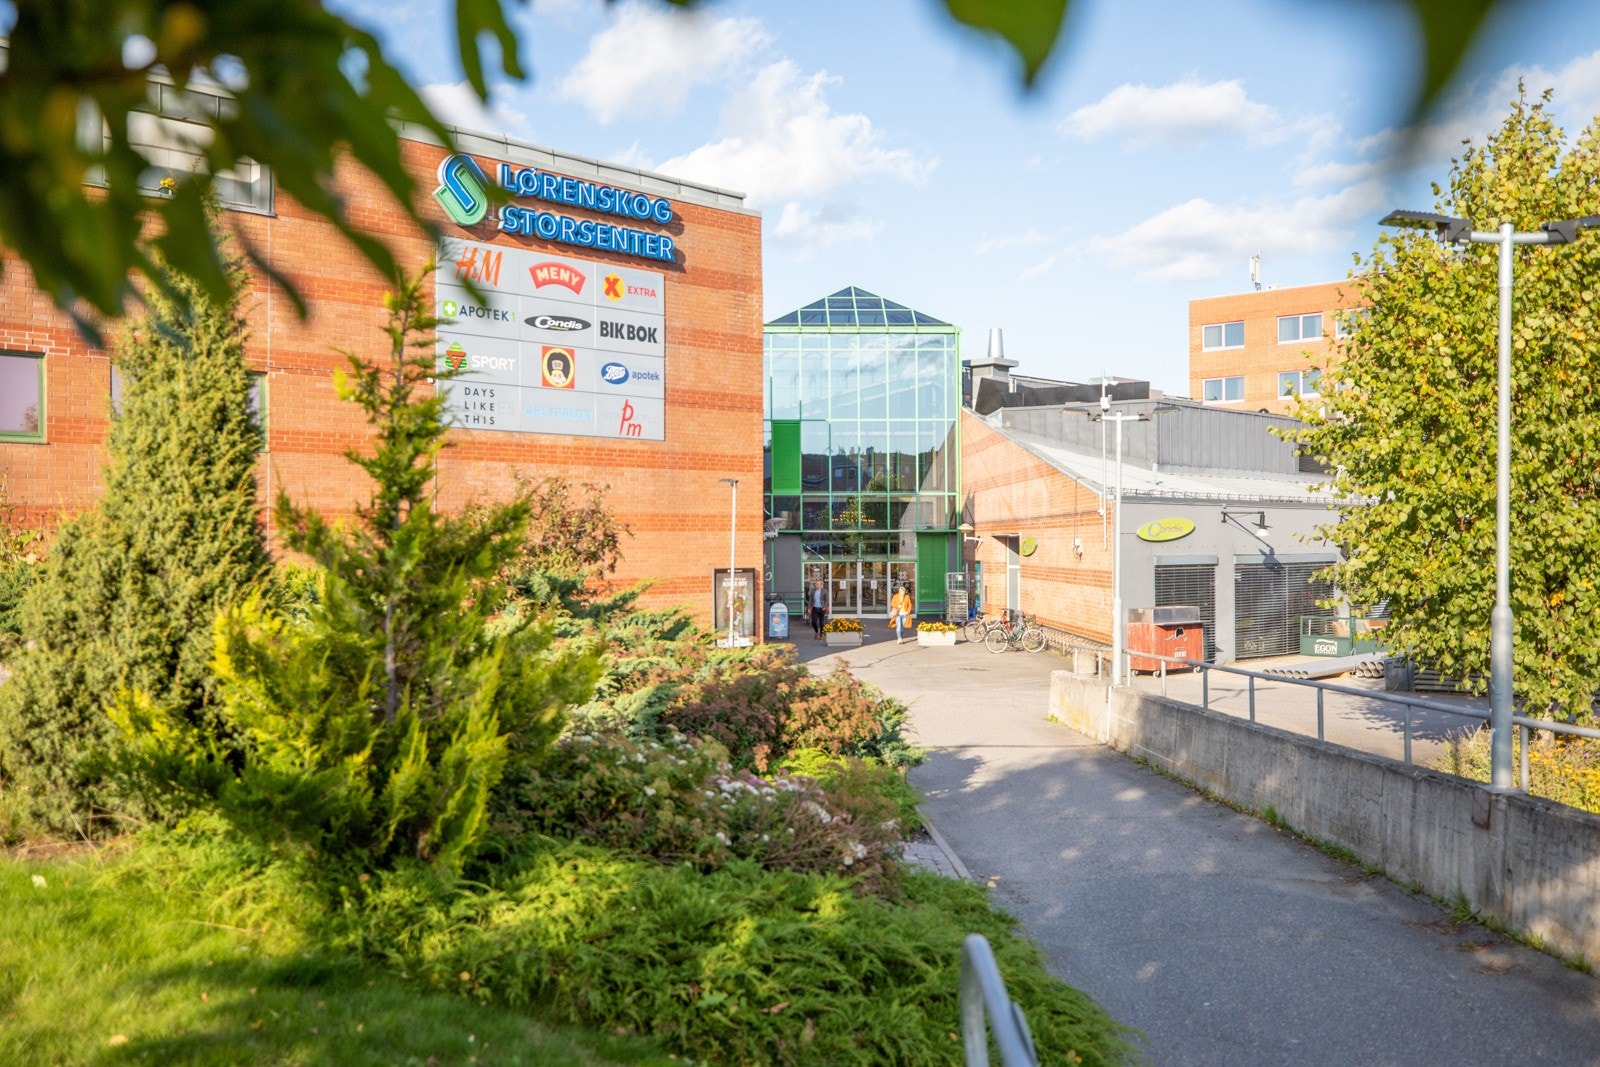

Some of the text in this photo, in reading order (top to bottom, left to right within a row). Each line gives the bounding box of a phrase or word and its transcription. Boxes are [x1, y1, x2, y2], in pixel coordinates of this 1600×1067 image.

[497, 163, 673, 224] LØRENSKOG
[498, 205, 676, 261] STORSENTER
[455, 246, 503, 288] H&M
[535, 266, 581, 287] MENY
[627, 285, 657, 298] EXTRA
[459, 305, 516, 322] APOTEK 1
[534, 315, 583, 330] Condis
[600, 320, 658, 344] BIK BOK
[471, 355, 516, 371] SPORT
[632, 371, 660, 381] apotek
[464, 387, 495, 398] DAYS
[464, 401, 495, 412] LIKE
[464, 415, 495, 425] THIS
[1314, 643, 1338, 652] EGON
